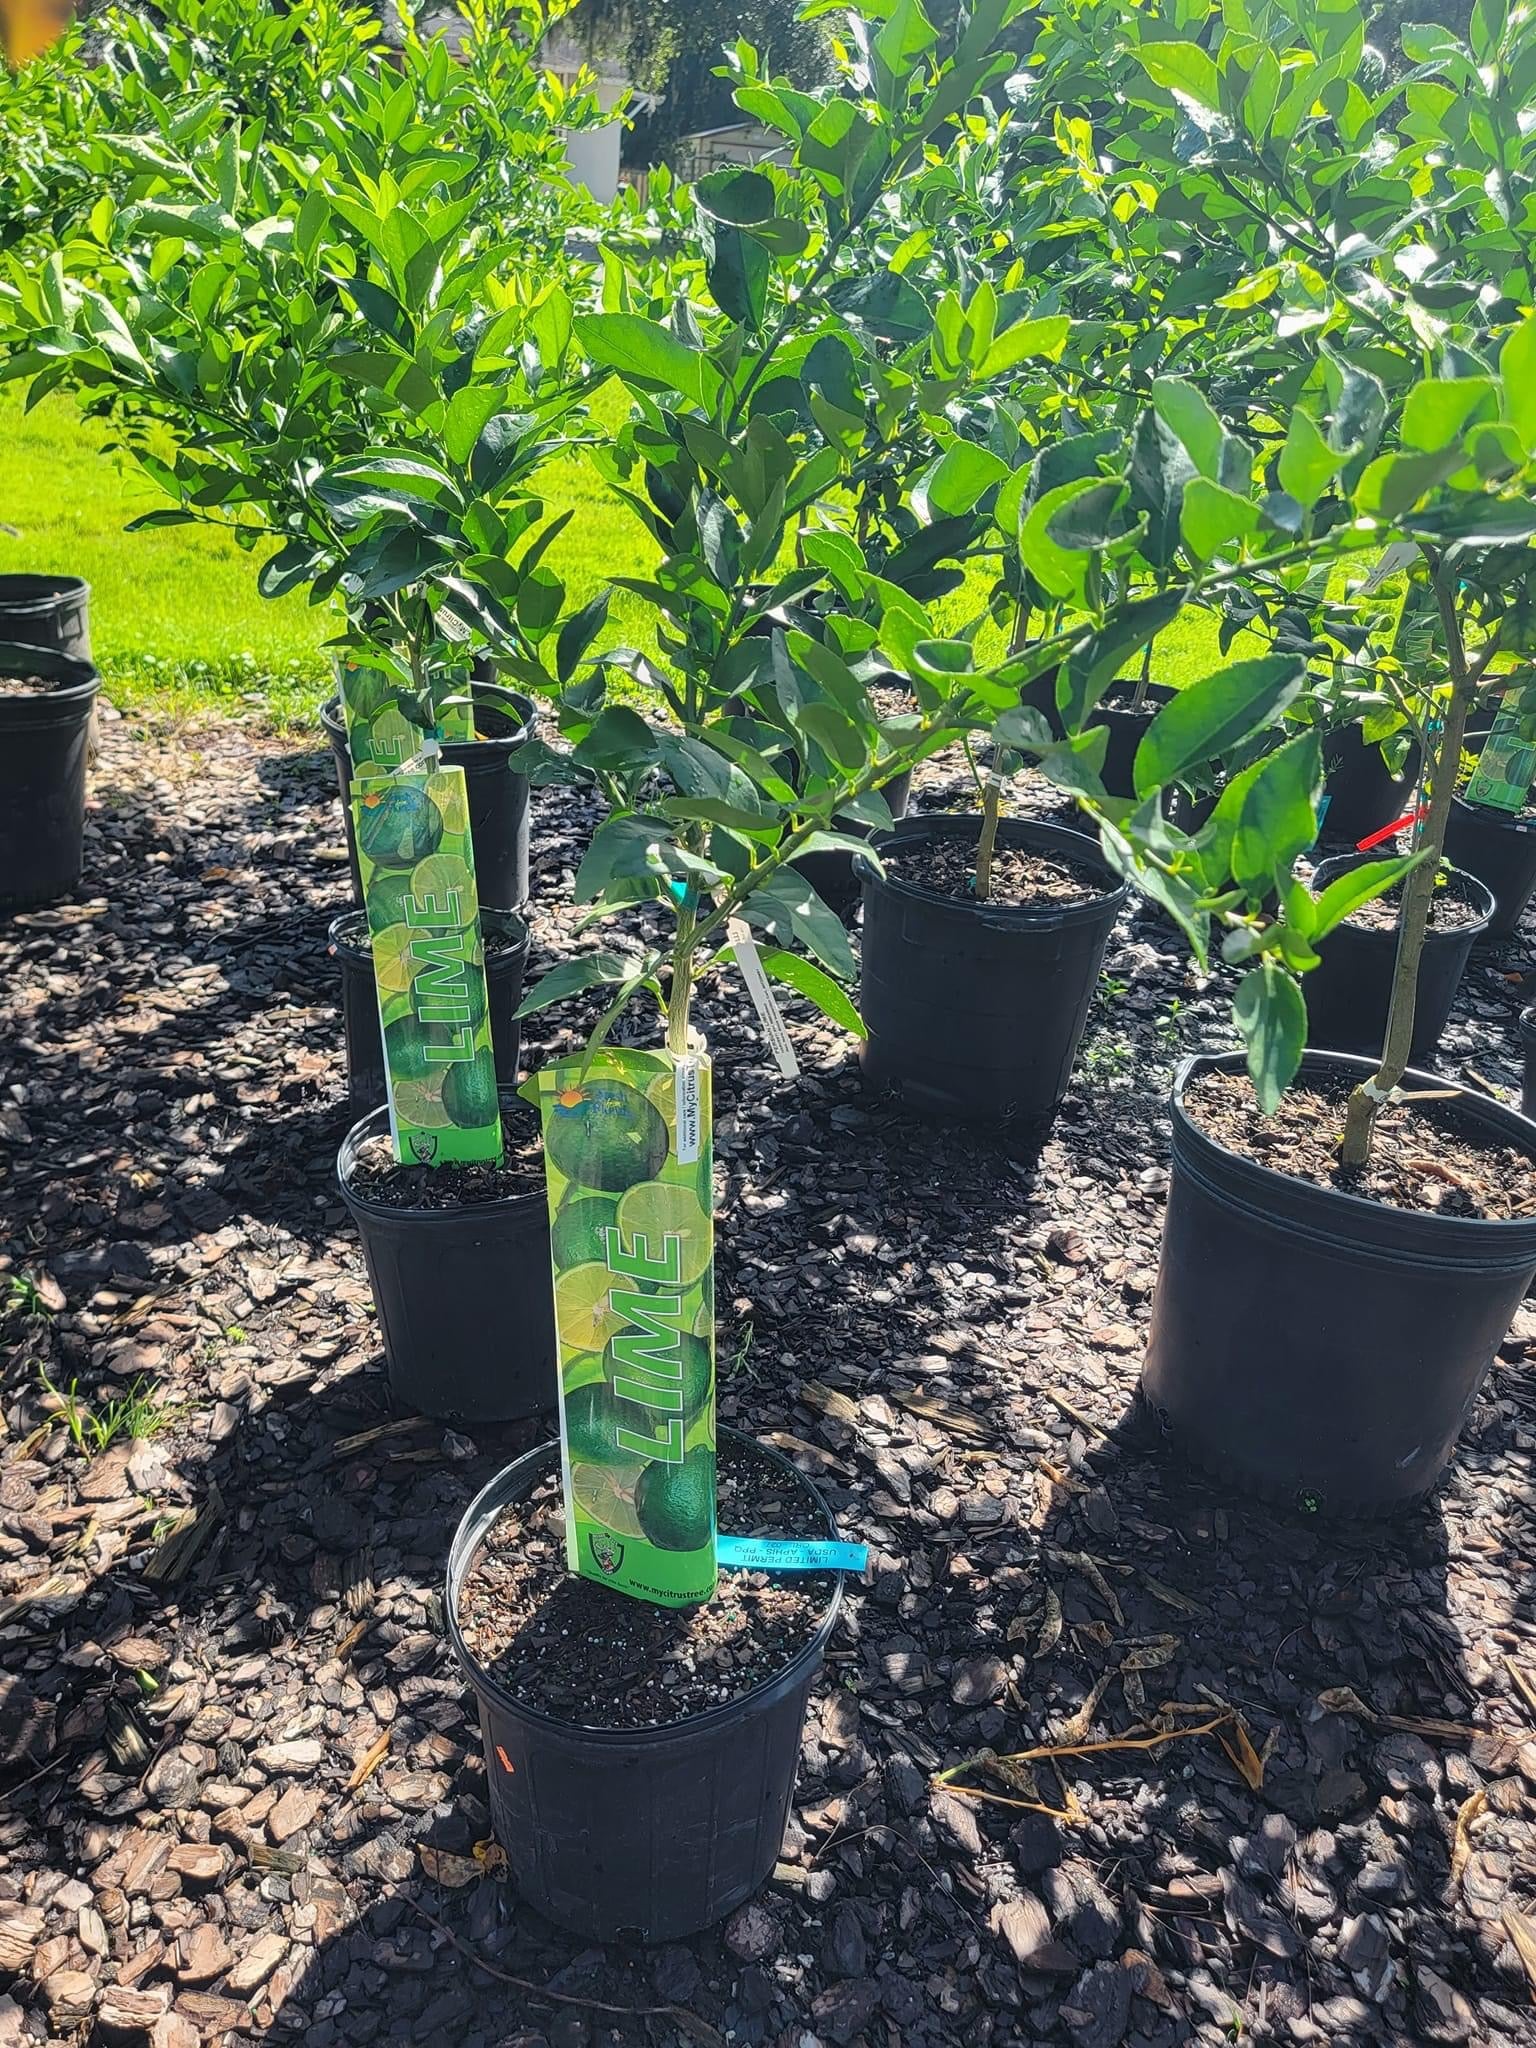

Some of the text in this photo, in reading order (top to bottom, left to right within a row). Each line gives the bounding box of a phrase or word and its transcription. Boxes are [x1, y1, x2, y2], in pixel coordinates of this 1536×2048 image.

[403, 890, 475, 1063] LIME
[605, 1226, 684, 1463] LIME
[765, 1547, 798, 1556] APHIS
[806, 1547, 837, 1556] USDA
[740, 1554, 829, 1565] LIMITED PERMIT
